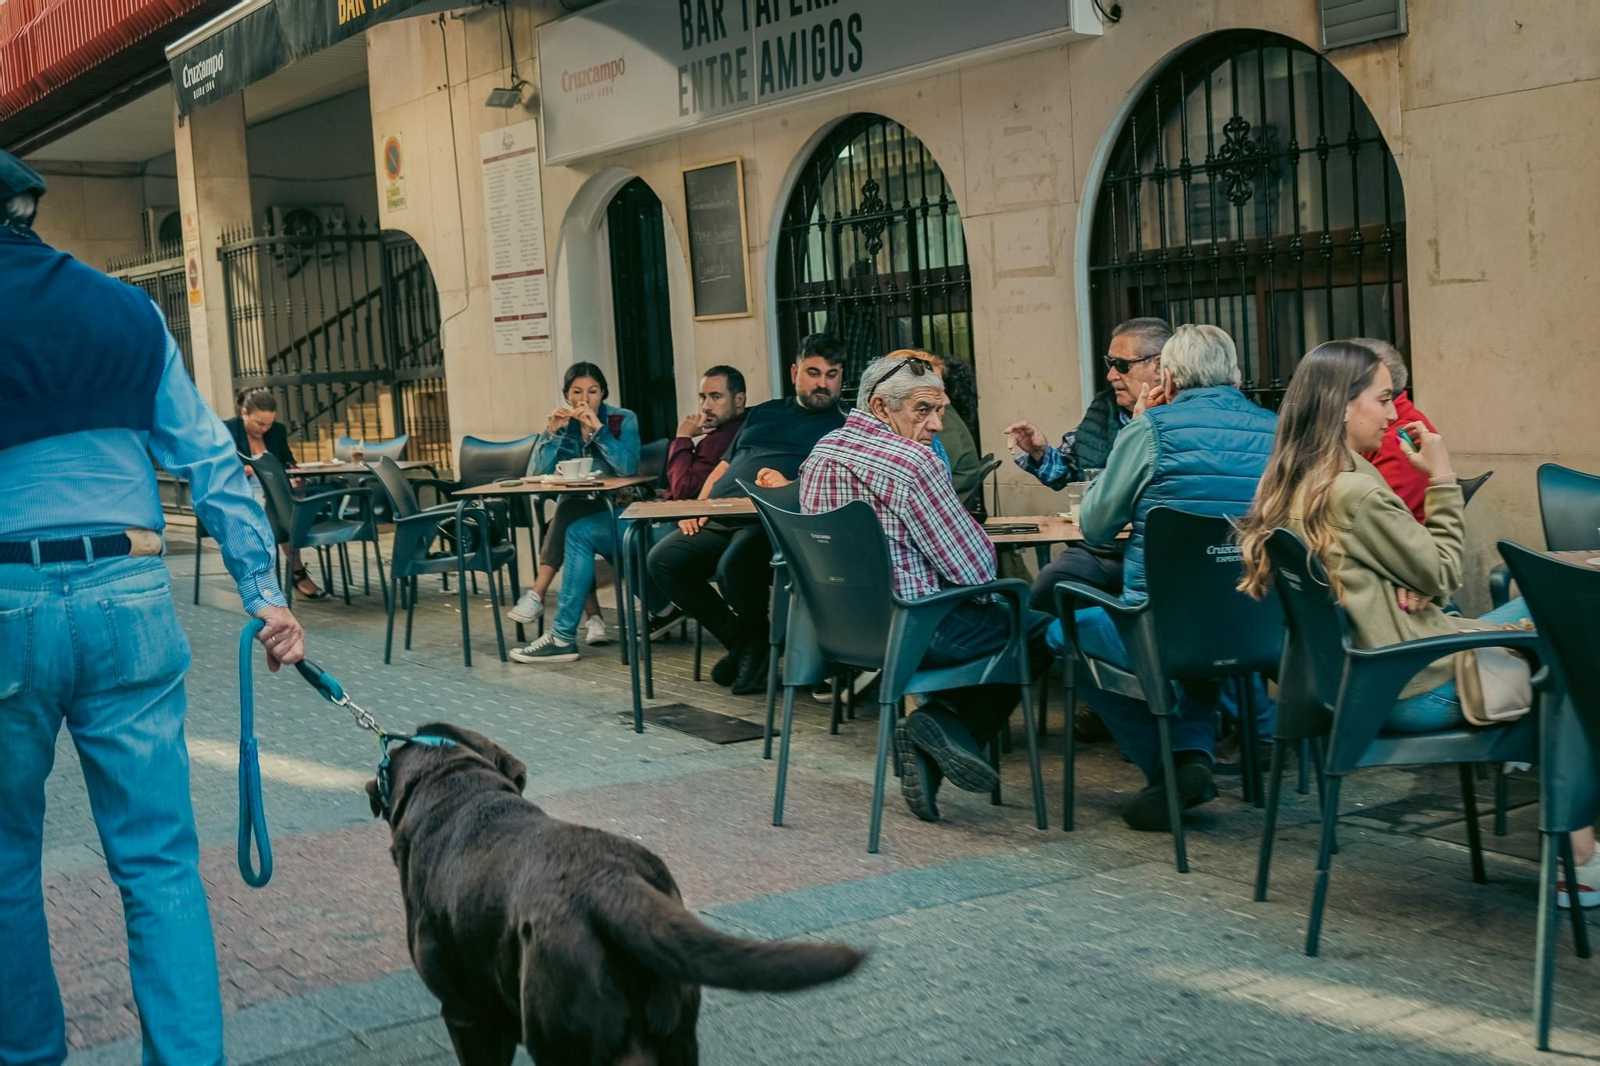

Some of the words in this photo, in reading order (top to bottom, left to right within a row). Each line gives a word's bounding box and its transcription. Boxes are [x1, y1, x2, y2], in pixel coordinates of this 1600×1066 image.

[679, 0, 727, 51] BAR
[183, 51, 224, 88] Cruzcampo
[562, 56, 625, 93] Cruzcampo
[677, 46, 749, 117] ENTRE
[760, 13, 863, 96] AMIGOS
